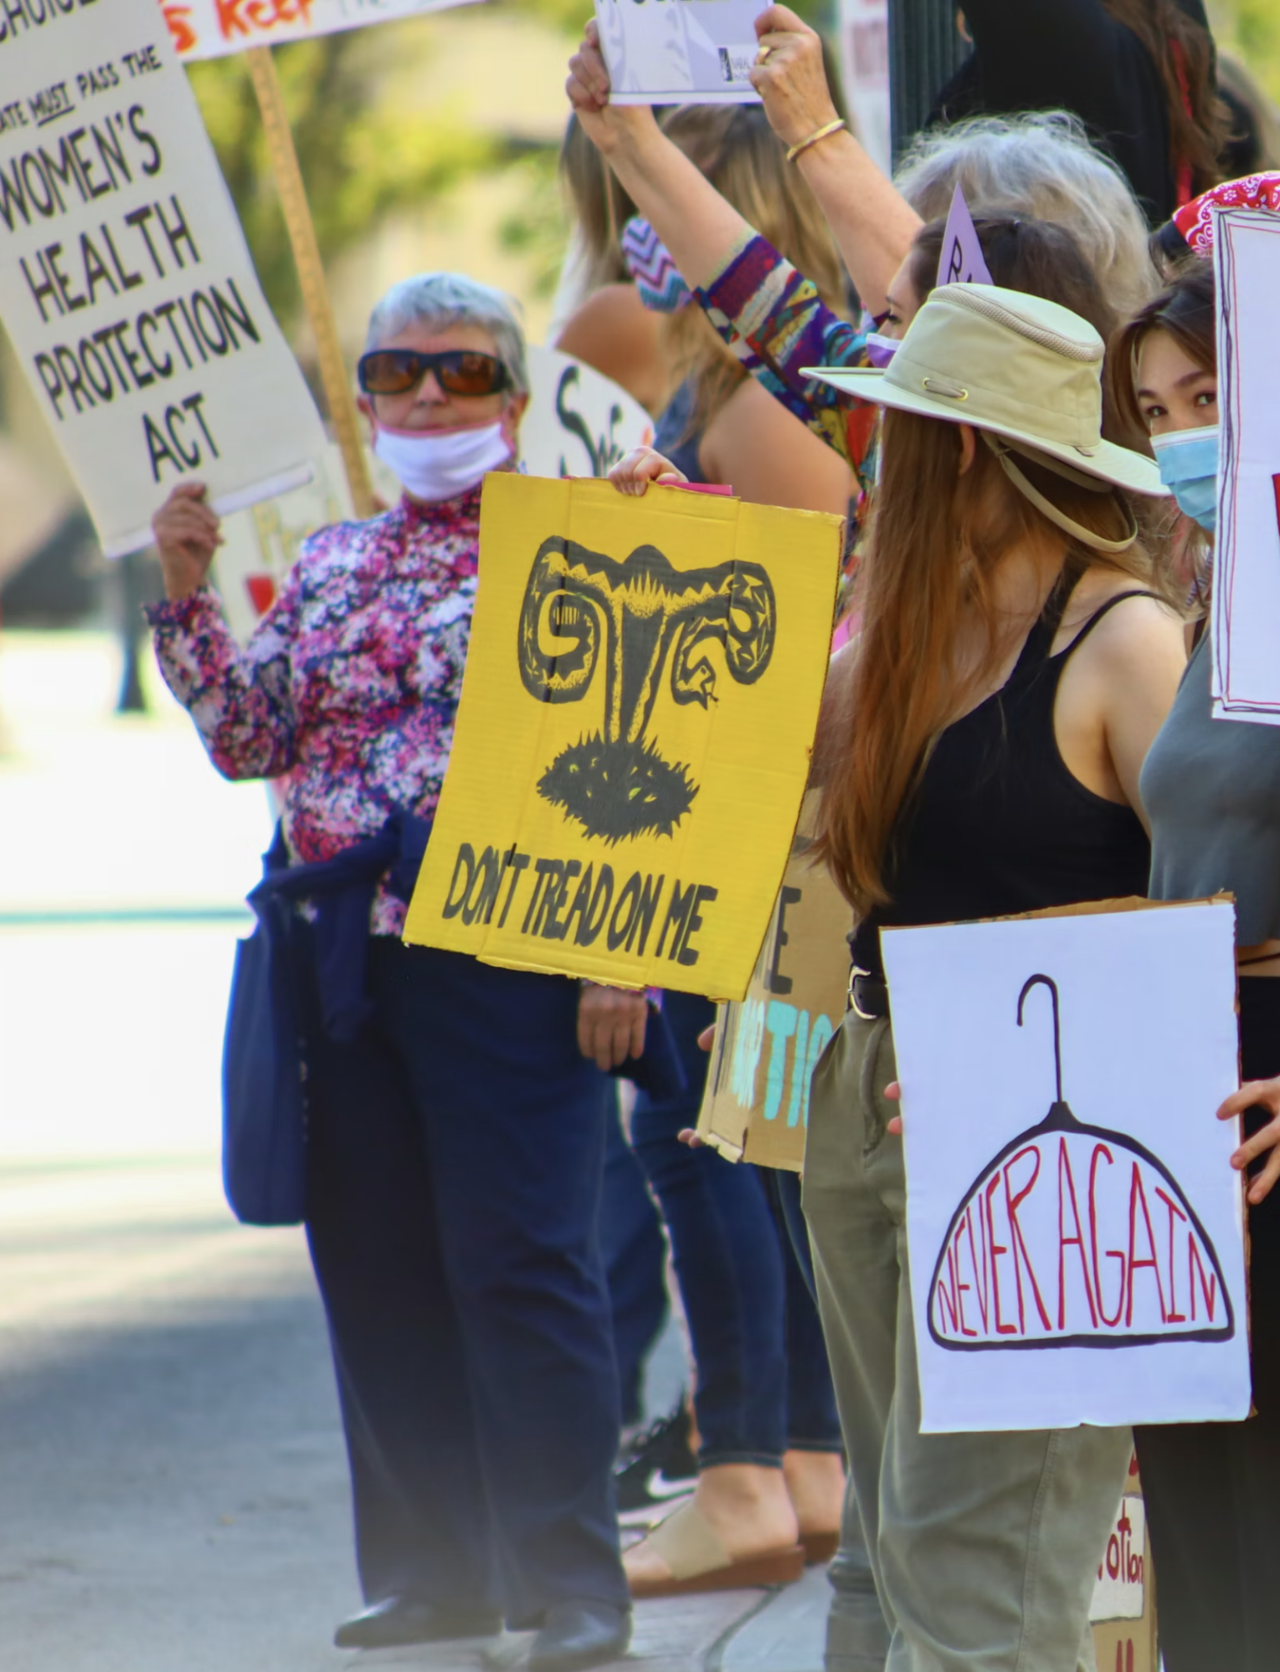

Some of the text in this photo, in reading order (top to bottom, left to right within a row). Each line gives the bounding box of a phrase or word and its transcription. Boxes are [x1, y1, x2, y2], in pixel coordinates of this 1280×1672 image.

[27, 81, 73, 122] MUST
[76, 62, 120, 99] PASS
[121, 44, 162, 77] THE
[0, 104, 162, 232] WOMEN'S
[19, 195, 201, 323] HEALTH
[34, 277, 261, 421] PROTECTION
[142, 392, 219, 483] ACT
[442, 842, 719, 966] DON'T TREAD ON ME
[938, 1136, 1215, 1337] NEVER AGAIN
[1098, 1499, 1144, 1585] otion
